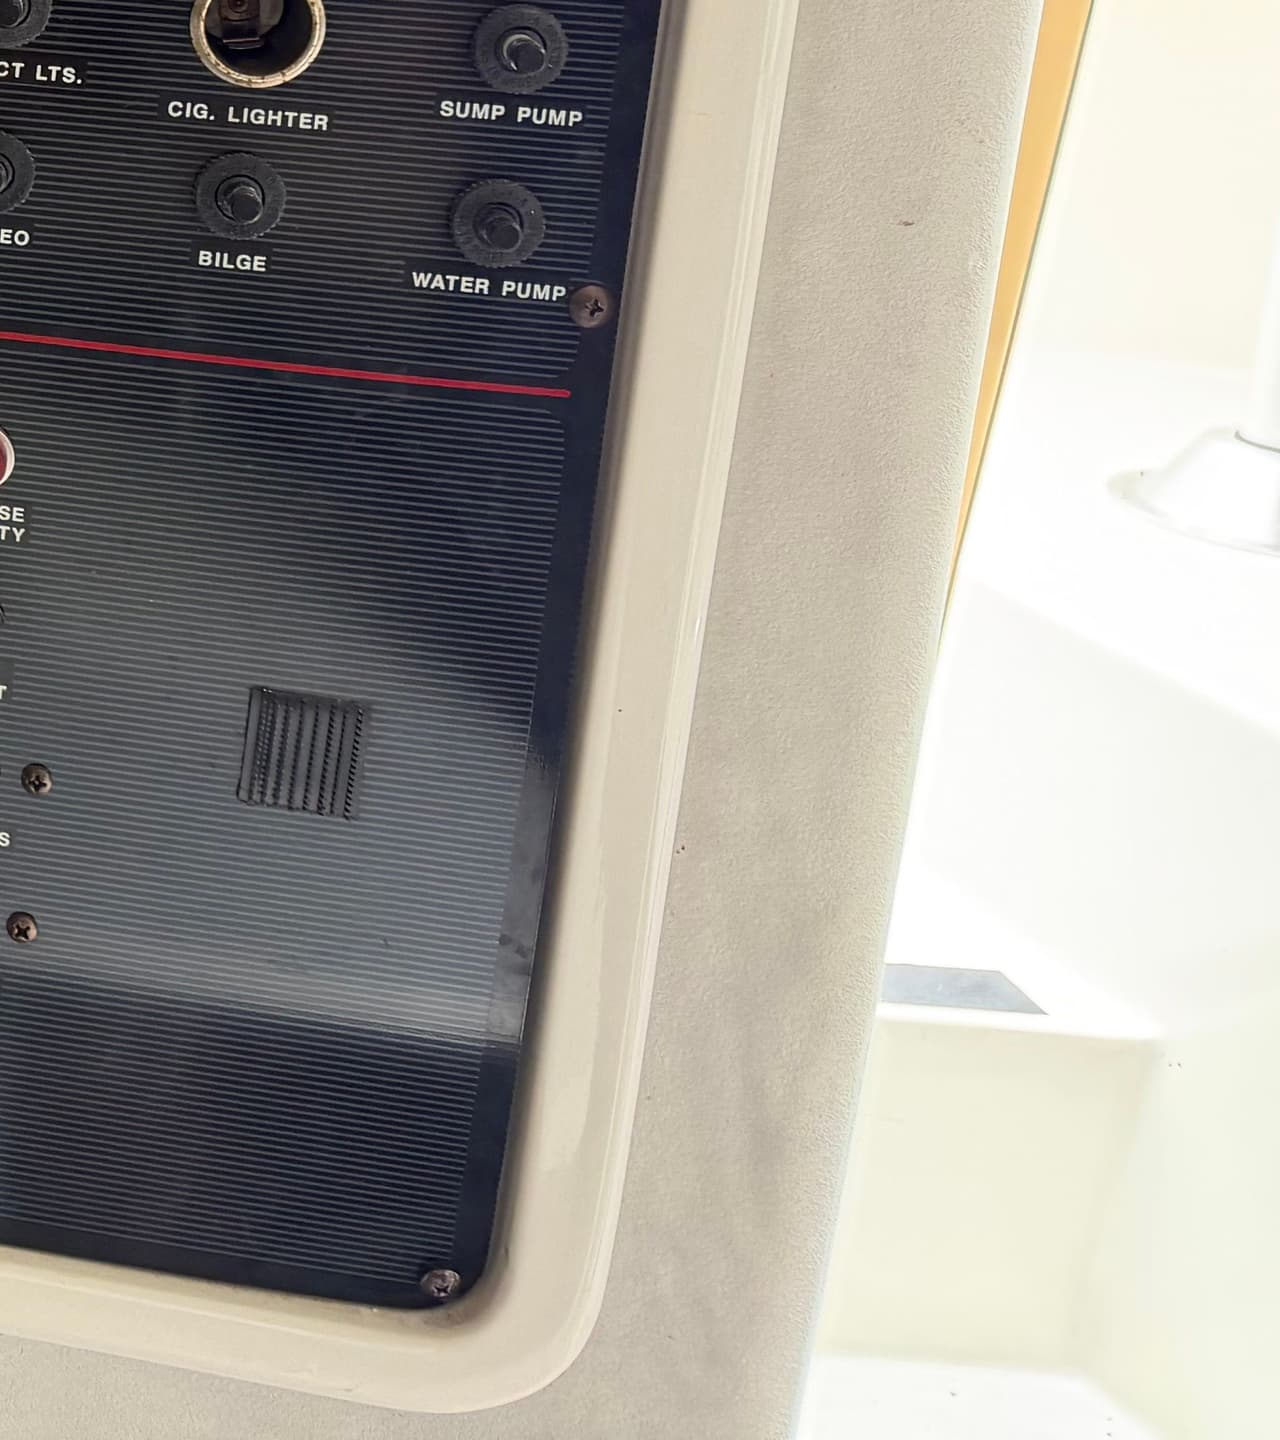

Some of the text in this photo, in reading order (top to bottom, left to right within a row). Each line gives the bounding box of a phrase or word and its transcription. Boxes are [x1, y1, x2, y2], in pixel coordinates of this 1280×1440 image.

[35, 65, 82, 84] LTS.
[167, 100, 330, 131] CIG. LIGHTER
[440, 100, 584, 127] SUMP PUMP
[198, 250, 267, 272] BILGE
[412, 271, 567, 302] WATER PUMP
